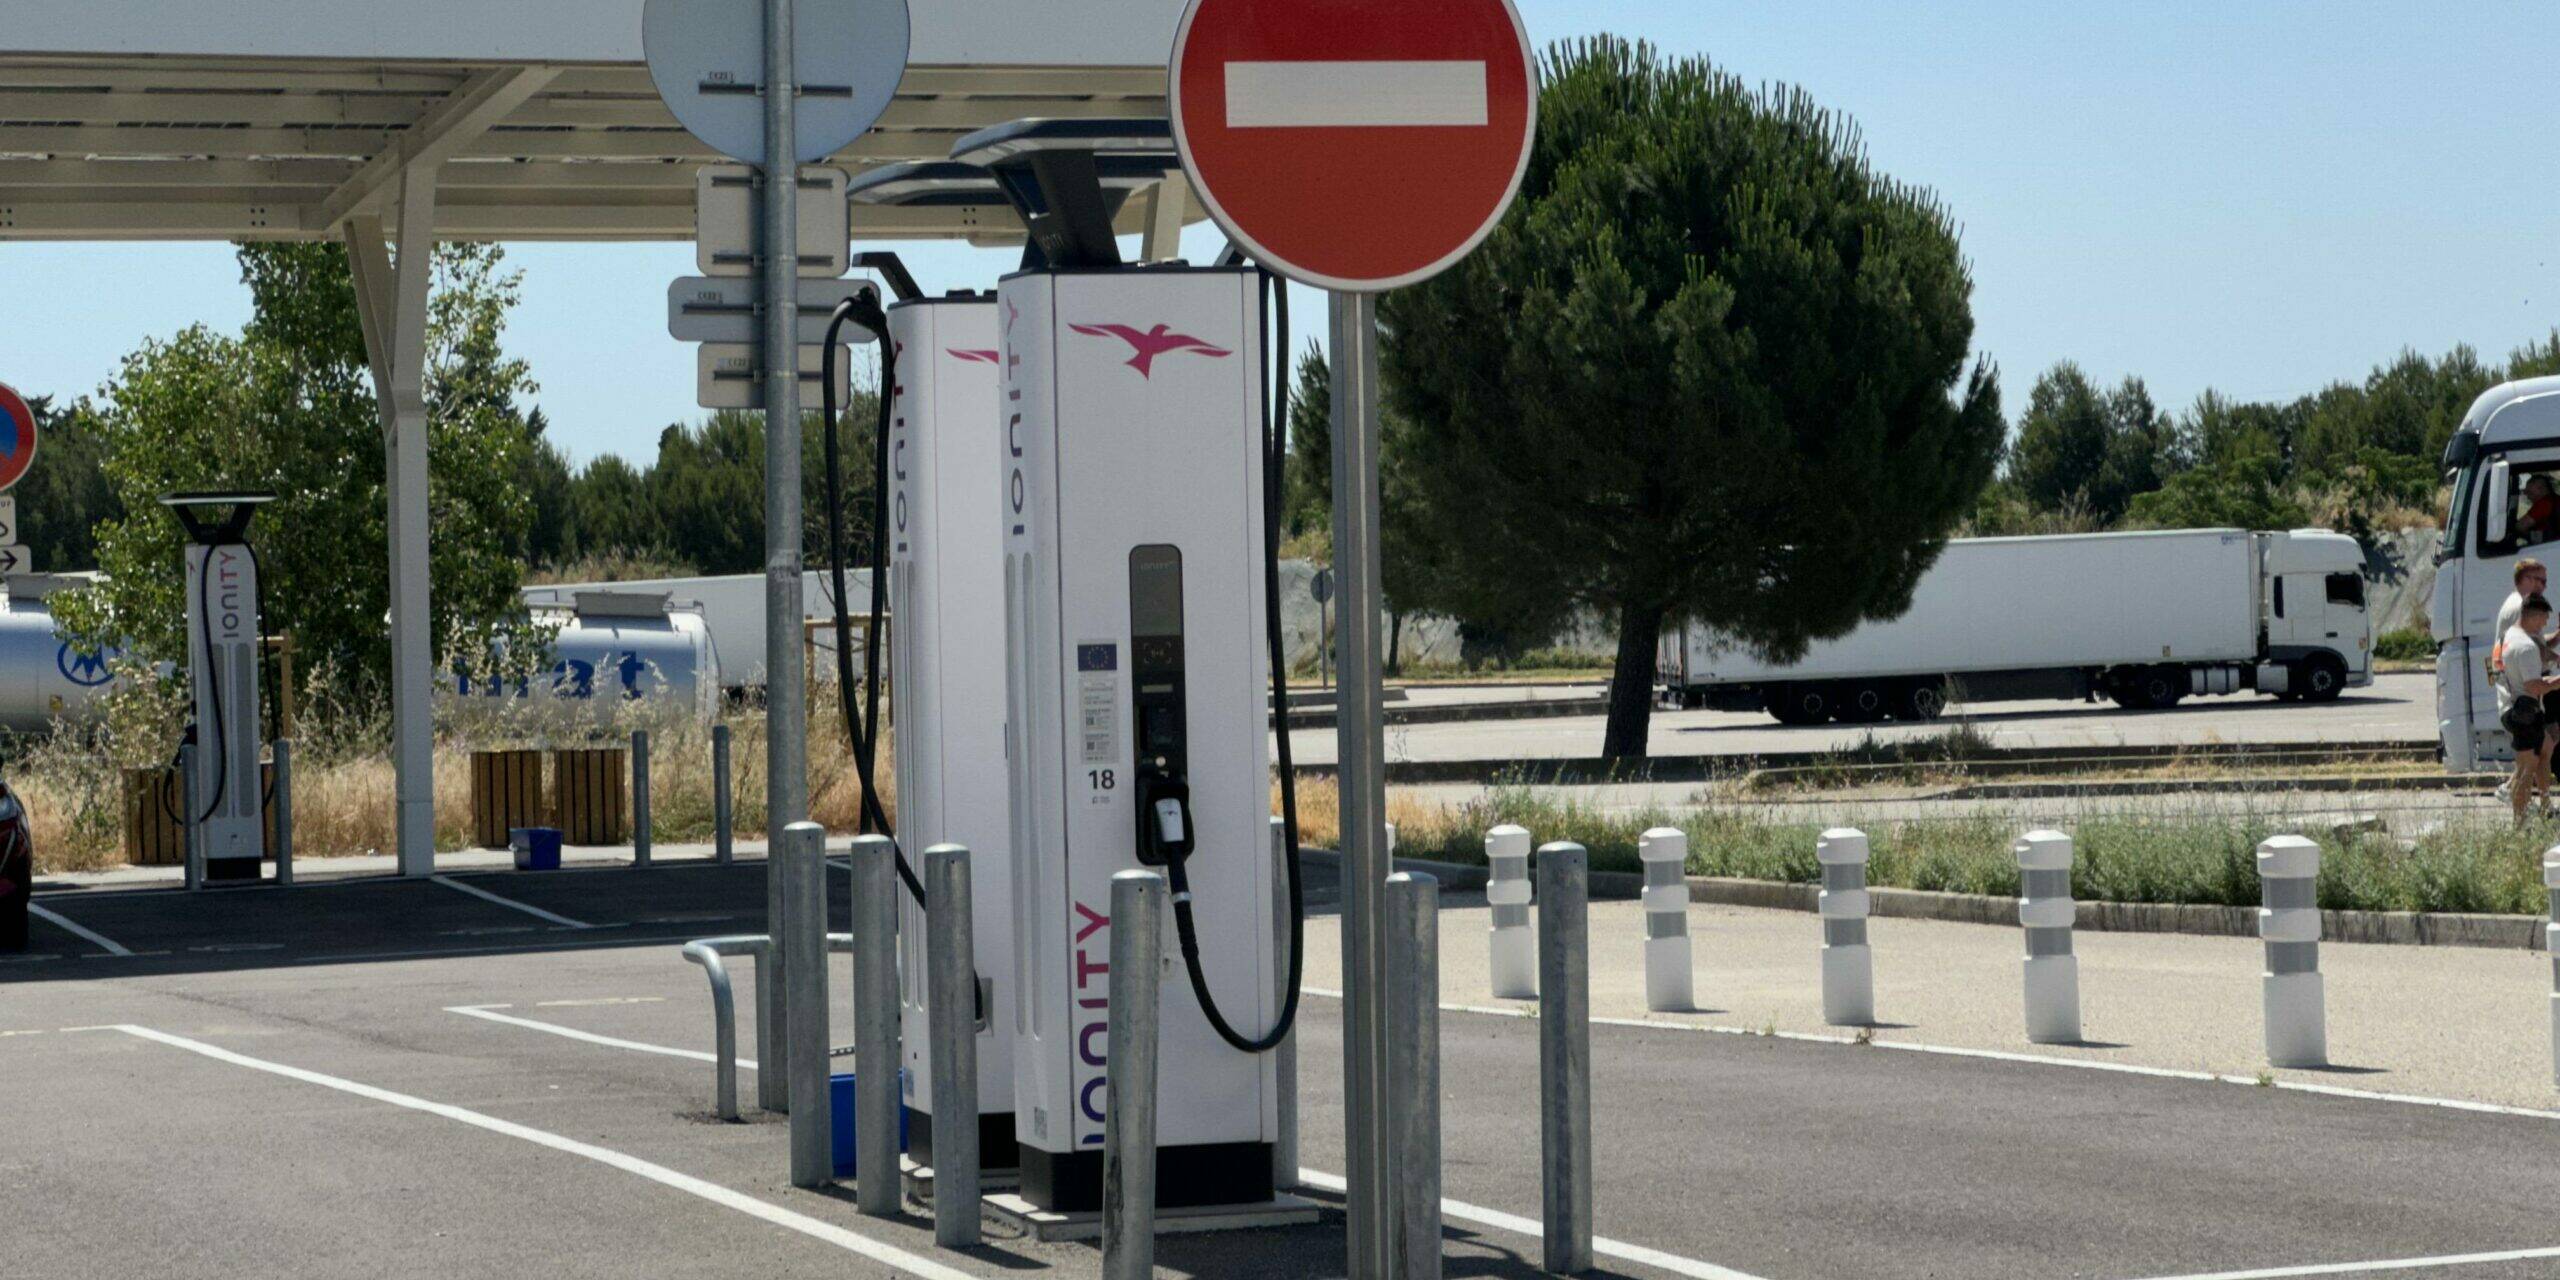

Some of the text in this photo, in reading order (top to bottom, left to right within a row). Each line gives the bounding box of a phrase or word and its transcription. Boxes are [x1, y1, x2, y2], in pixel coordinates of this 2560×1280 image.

[1006, 294, 1025, 536] IONITY
[219, 551, 240, 638] IONITY
[1088, 769, 1115, 790] 18
[1075, 901, 1111, 1145] IONITY
